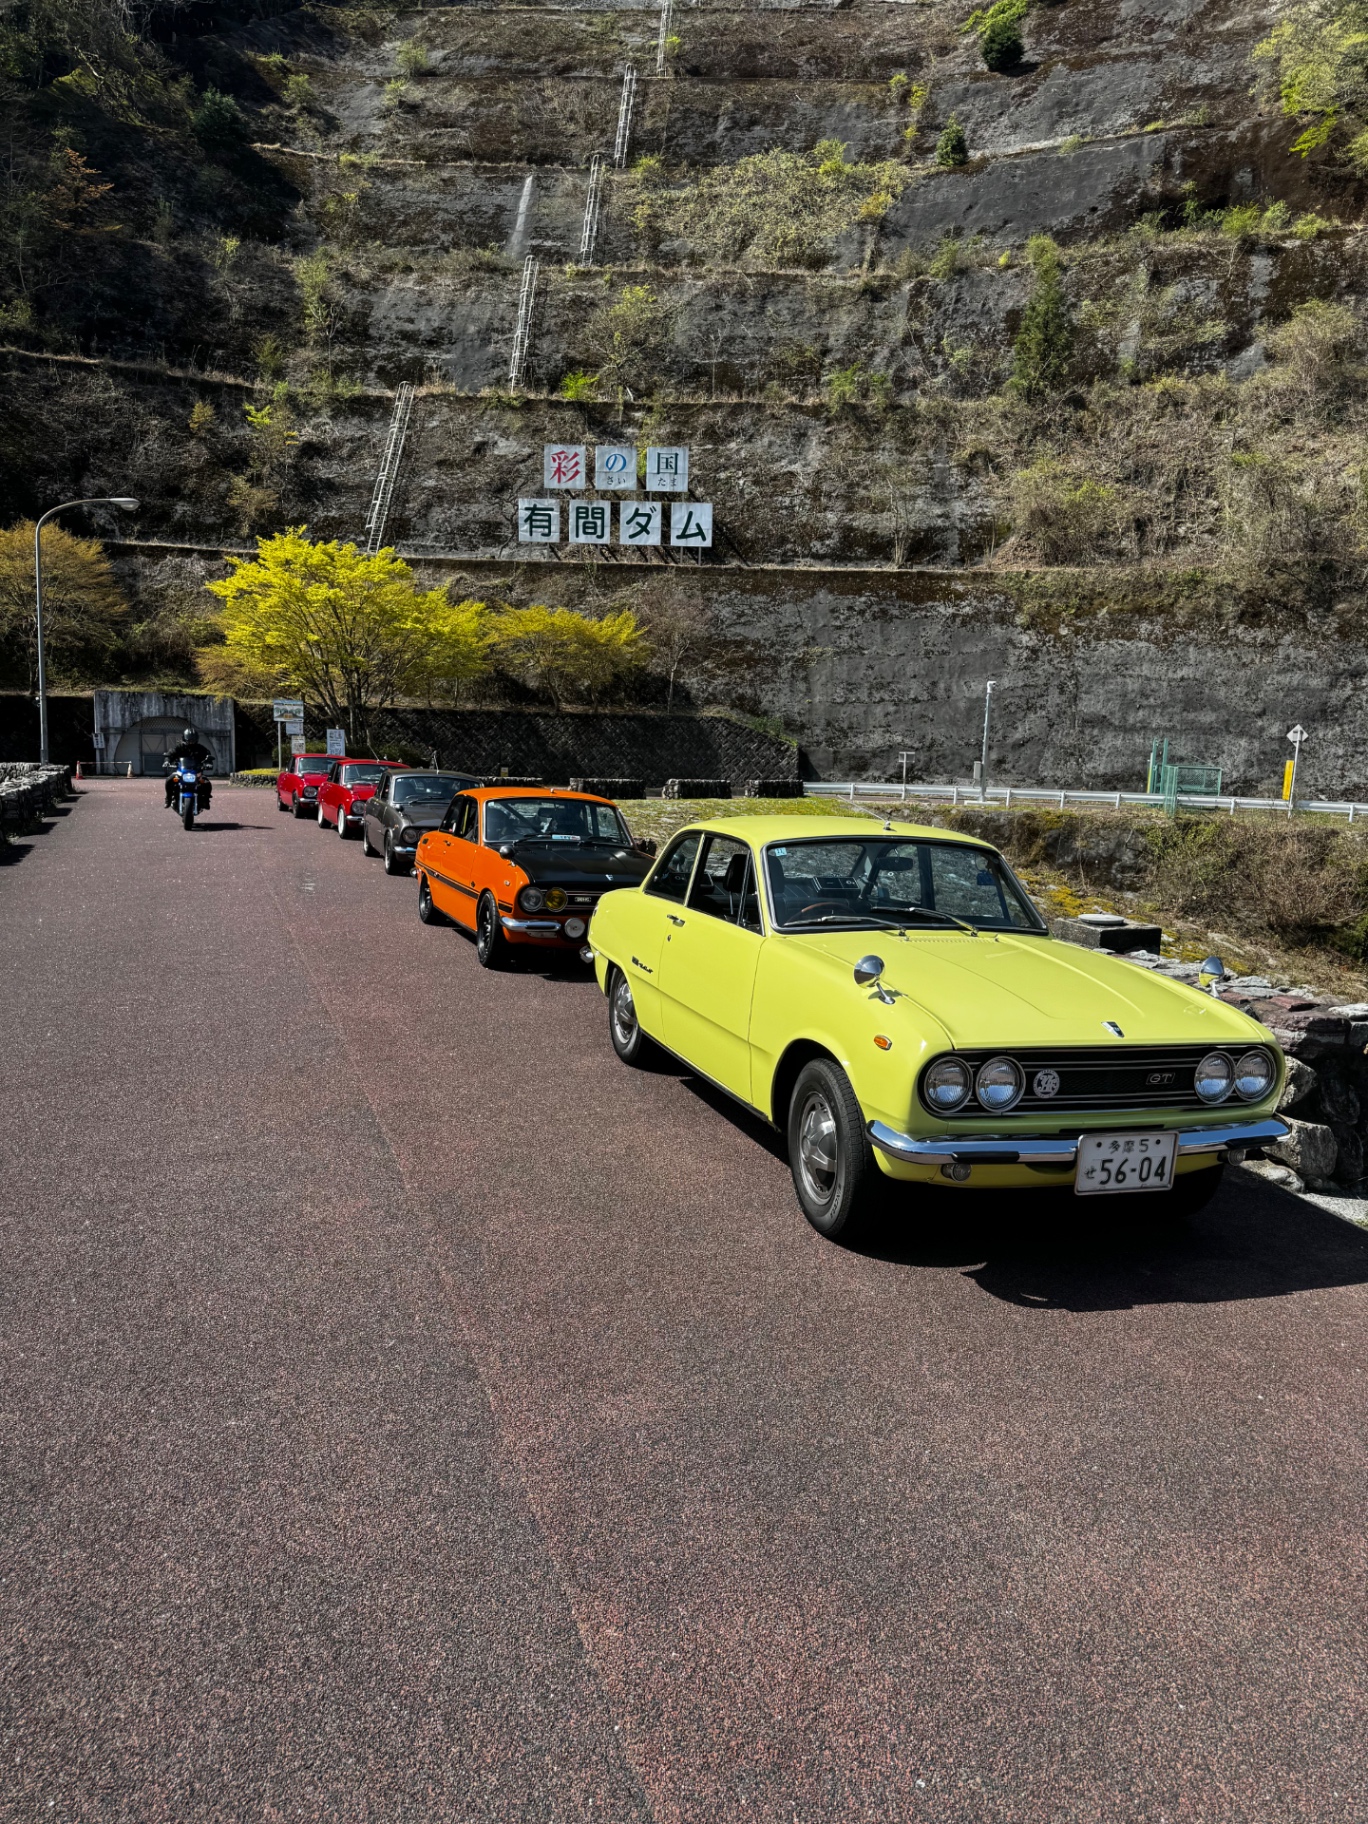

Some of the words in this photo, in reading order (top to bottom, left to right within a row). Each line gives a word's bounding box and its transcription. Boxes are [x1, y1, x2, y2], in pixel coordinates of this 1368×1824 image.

[550, 450, 680, 485] 彩の国
[524, 503, 707, 542] 有間ダム
[1149, 1073, 1172, 1083] GT
[1099, 1156, 1166, 1185] 56-04
